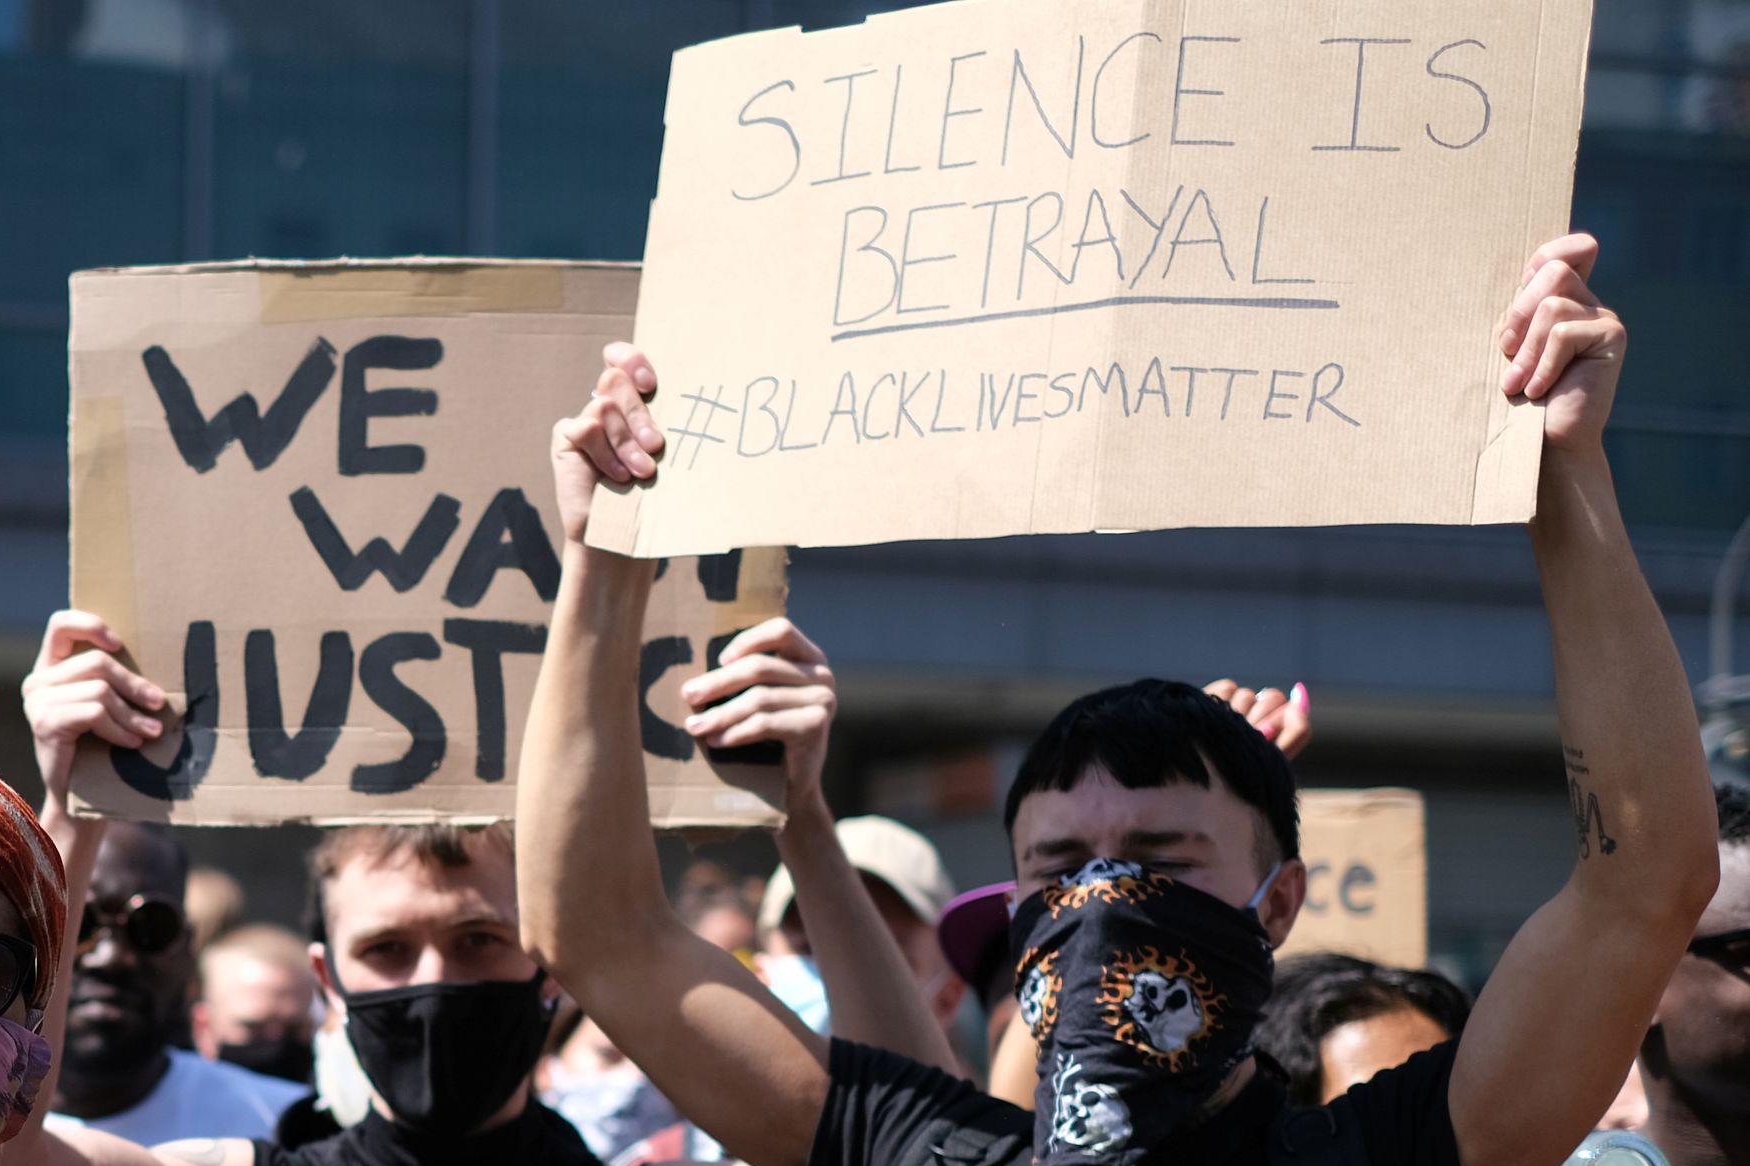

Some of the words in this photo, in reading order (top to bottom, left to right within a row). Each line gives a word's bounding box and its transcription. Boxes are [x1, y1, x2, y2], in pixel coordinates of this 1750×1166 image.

[730, 31, 1242, 201] SILENCE
[1310, 37, 1492, 152] IS
[832, 184, 1316, 328] BETRAYAL
[142, 335, 444, 477] WE
[666, 356, 1361, 471] #BLACKLIVESMATTER
[109, 618, 783, 801] JUSTC
